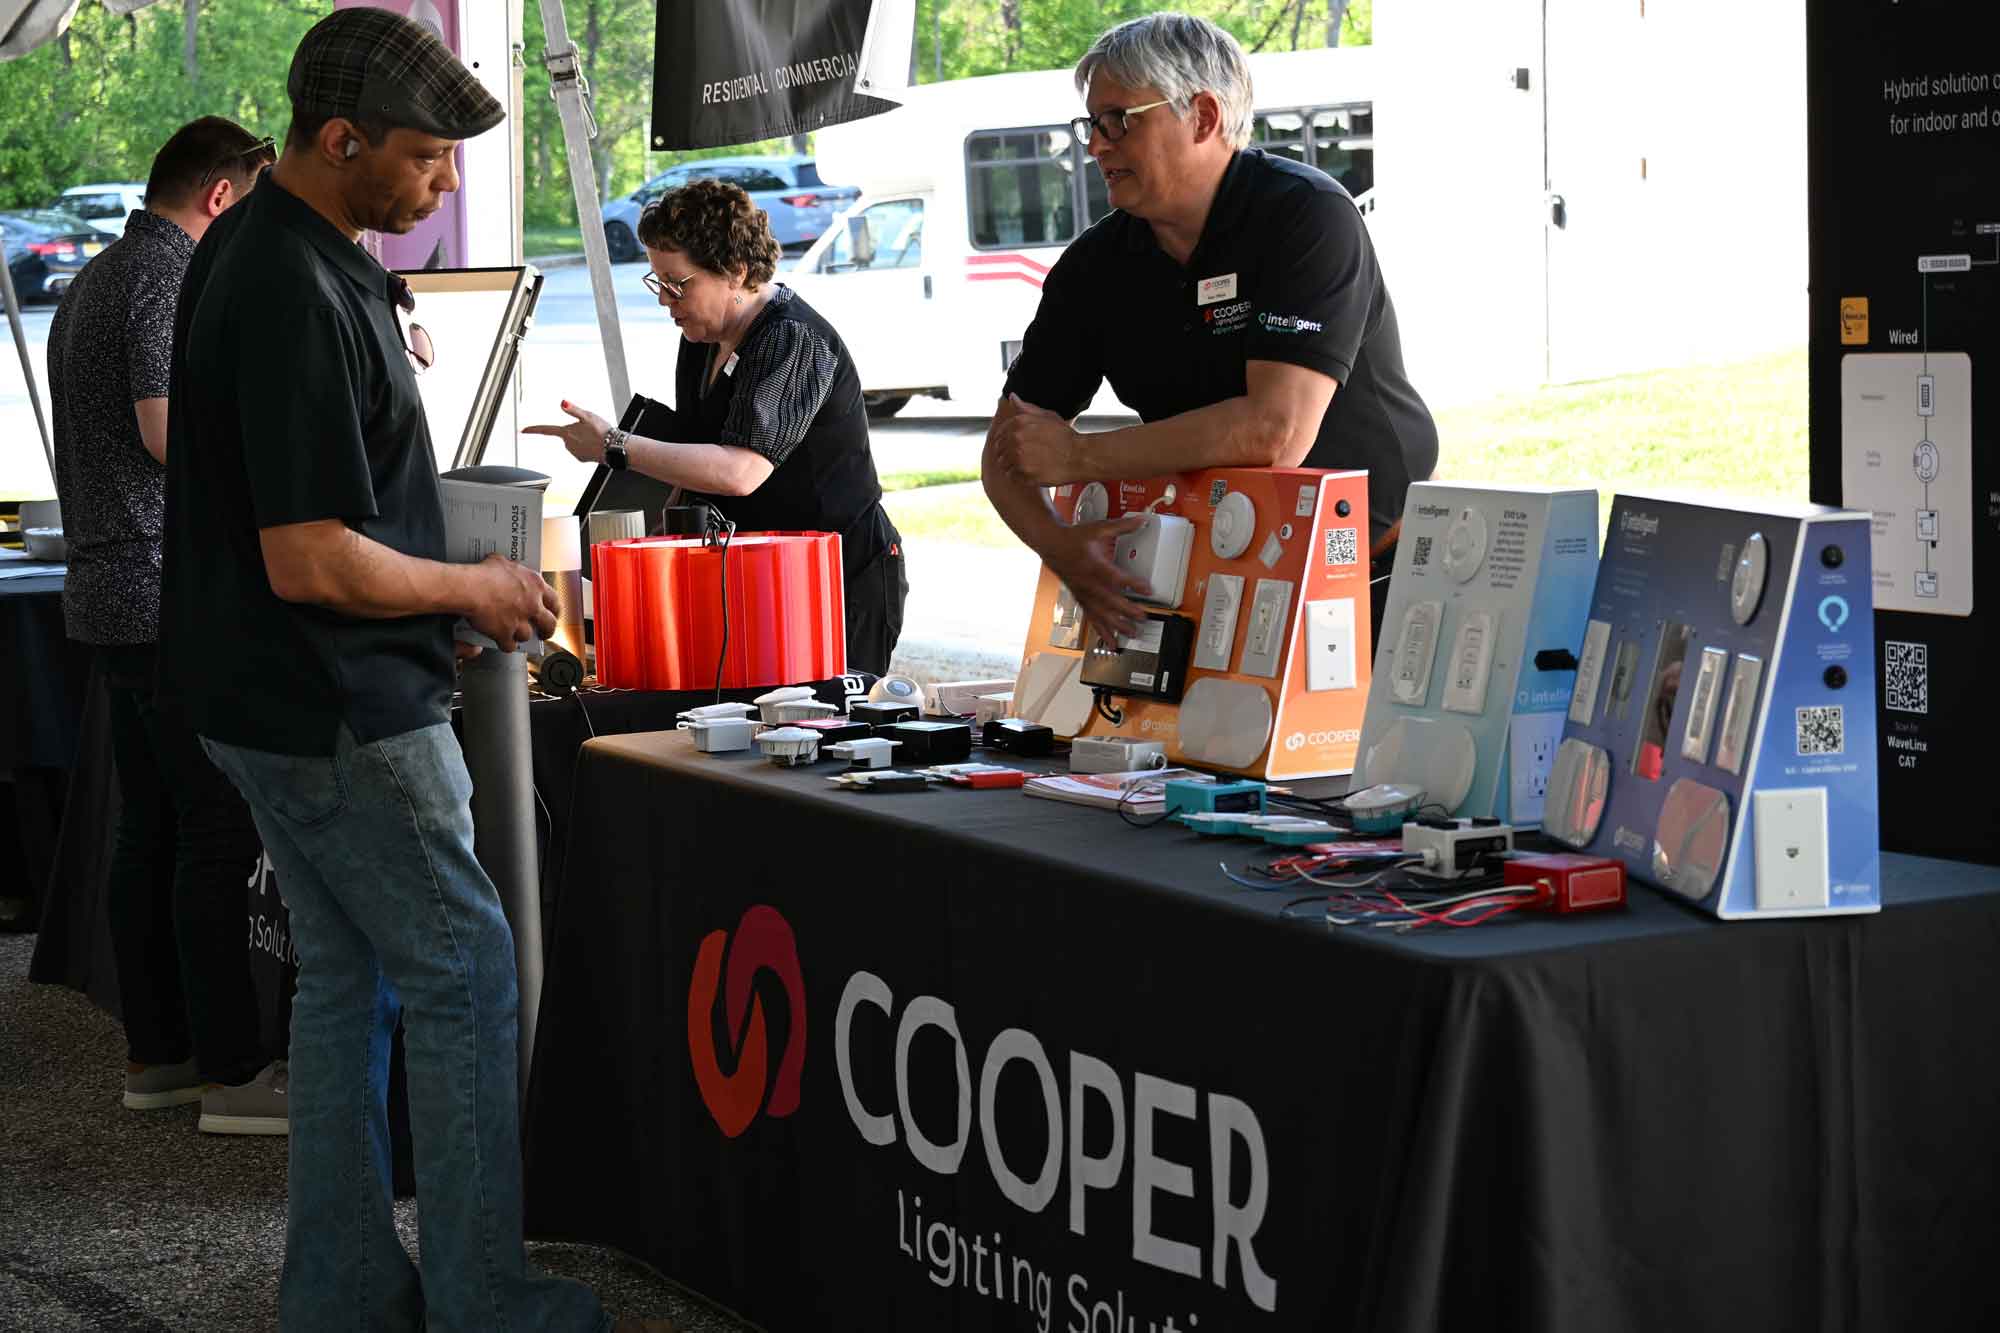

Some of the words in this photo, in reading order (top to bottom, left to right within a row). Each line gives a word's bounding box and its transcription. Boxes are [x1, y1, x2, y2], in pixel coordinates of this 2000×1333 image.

[1884, 75, 1928, 105] Hybrid
[1932, 72, 1989, 96] solution
[1890, 112, 1909, 136] for
[1913, 111, 1958, 133] indoor
[1961, 104, 1988, 129] and
[1213, 301, 1251, 319] COOPER
[1267, 312, 1323, 333] intelligent
[1889, 328, 1918, 345] Wired
[511, 505, 520, 534] STOCK
[1887, 736, 1928, 752] WaveLinx
[1898, 754, 1917, 769] CAT
[835, 970, 1277, 1312] COOPER
